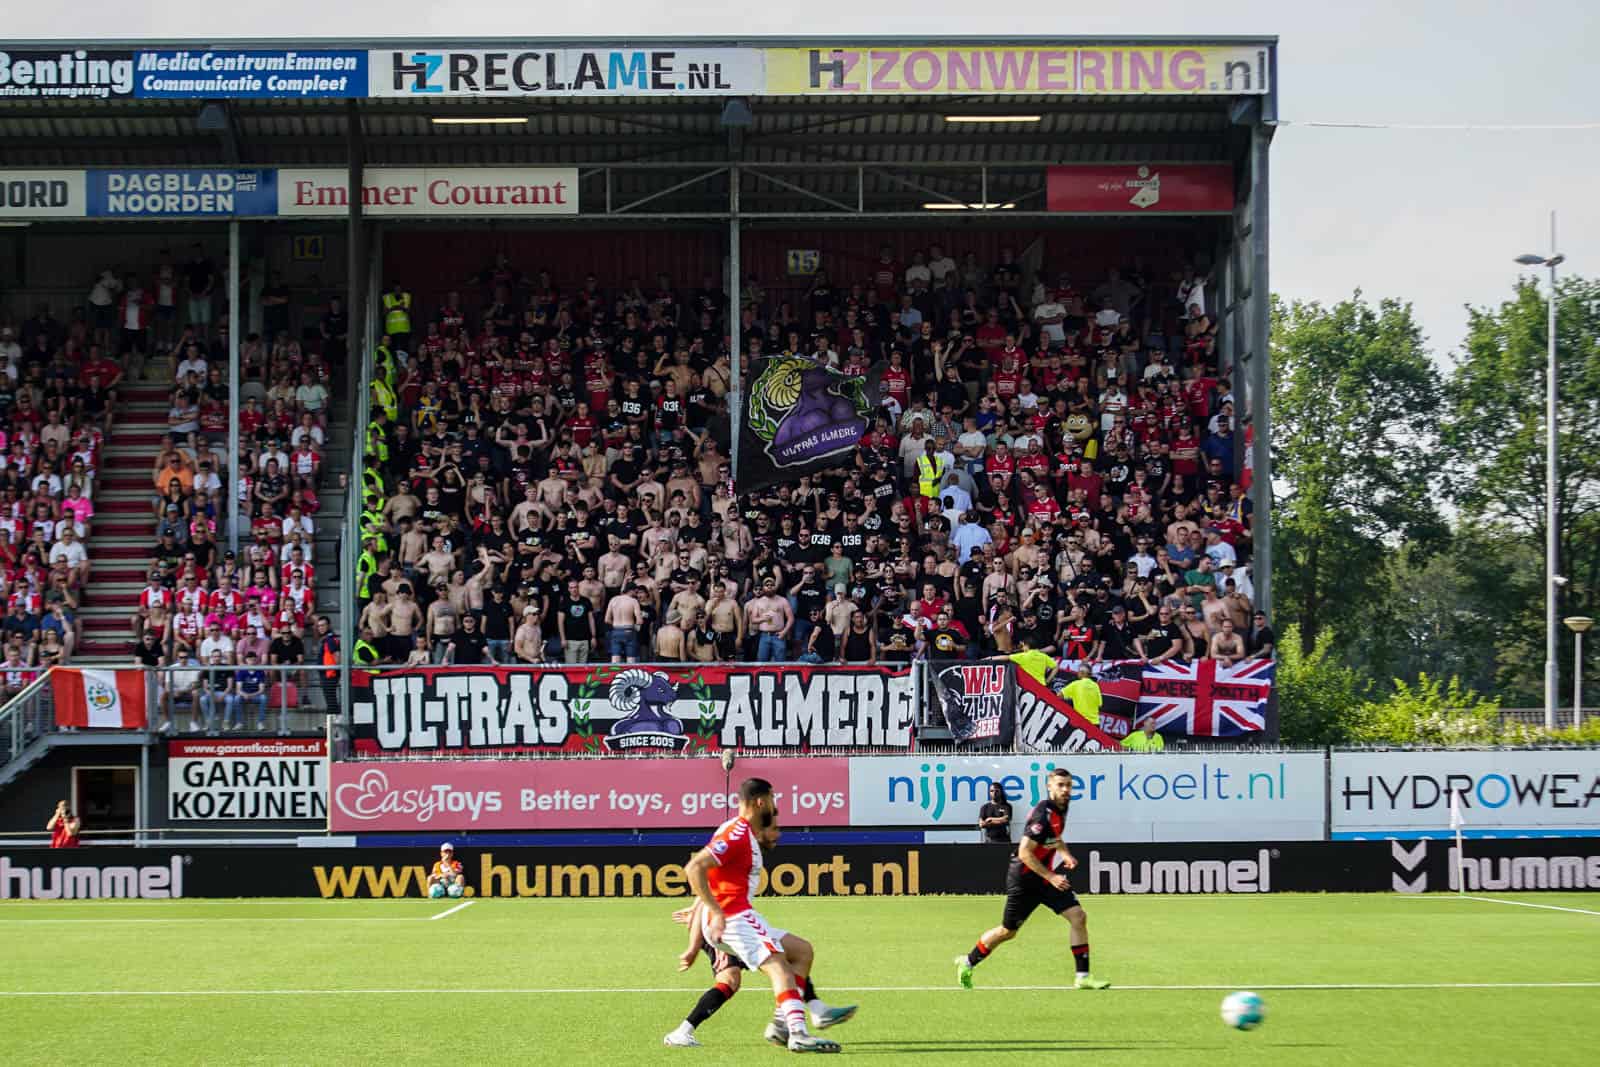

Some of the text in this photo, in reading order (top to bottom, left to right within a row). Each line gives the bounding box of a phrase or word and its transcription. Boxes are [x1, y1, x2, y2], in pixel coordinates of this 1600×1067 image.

[137, 52, 357, 71] MediaCentrumEmmen
[143, 75, 347, 95] Communicatie Compleet
[108, 174, 234, 191] DAGBLAD
[428, 180, 567, 205] Courant
[108, 194, 234, 212] NOORDEN
[622, 401, 641, 414] 036
[811, 534, 832, 546] 036
[842, 534, 861, 546] 036
[961, 665, 1005, 696] WIJ
[373, 673, 914, 749] ULTRAS ALMERE
[184, 742, 320, 755] www.garantkozijnen.nl
[620, 735, 675, 748] SINCE 2005
[183, 760, 320, 787] GARANT
[1118, 763, 1286, 801] koelt.nl
[352, 780, 502, 822] EasyToys
[520, 789, 600, 811] Better
[608, 789, 672, 816] toys,
[792, 785, 845, 815] joys
[0, 855, 183, 899] hummel
[1089, 849, 1270, 893] hummel
